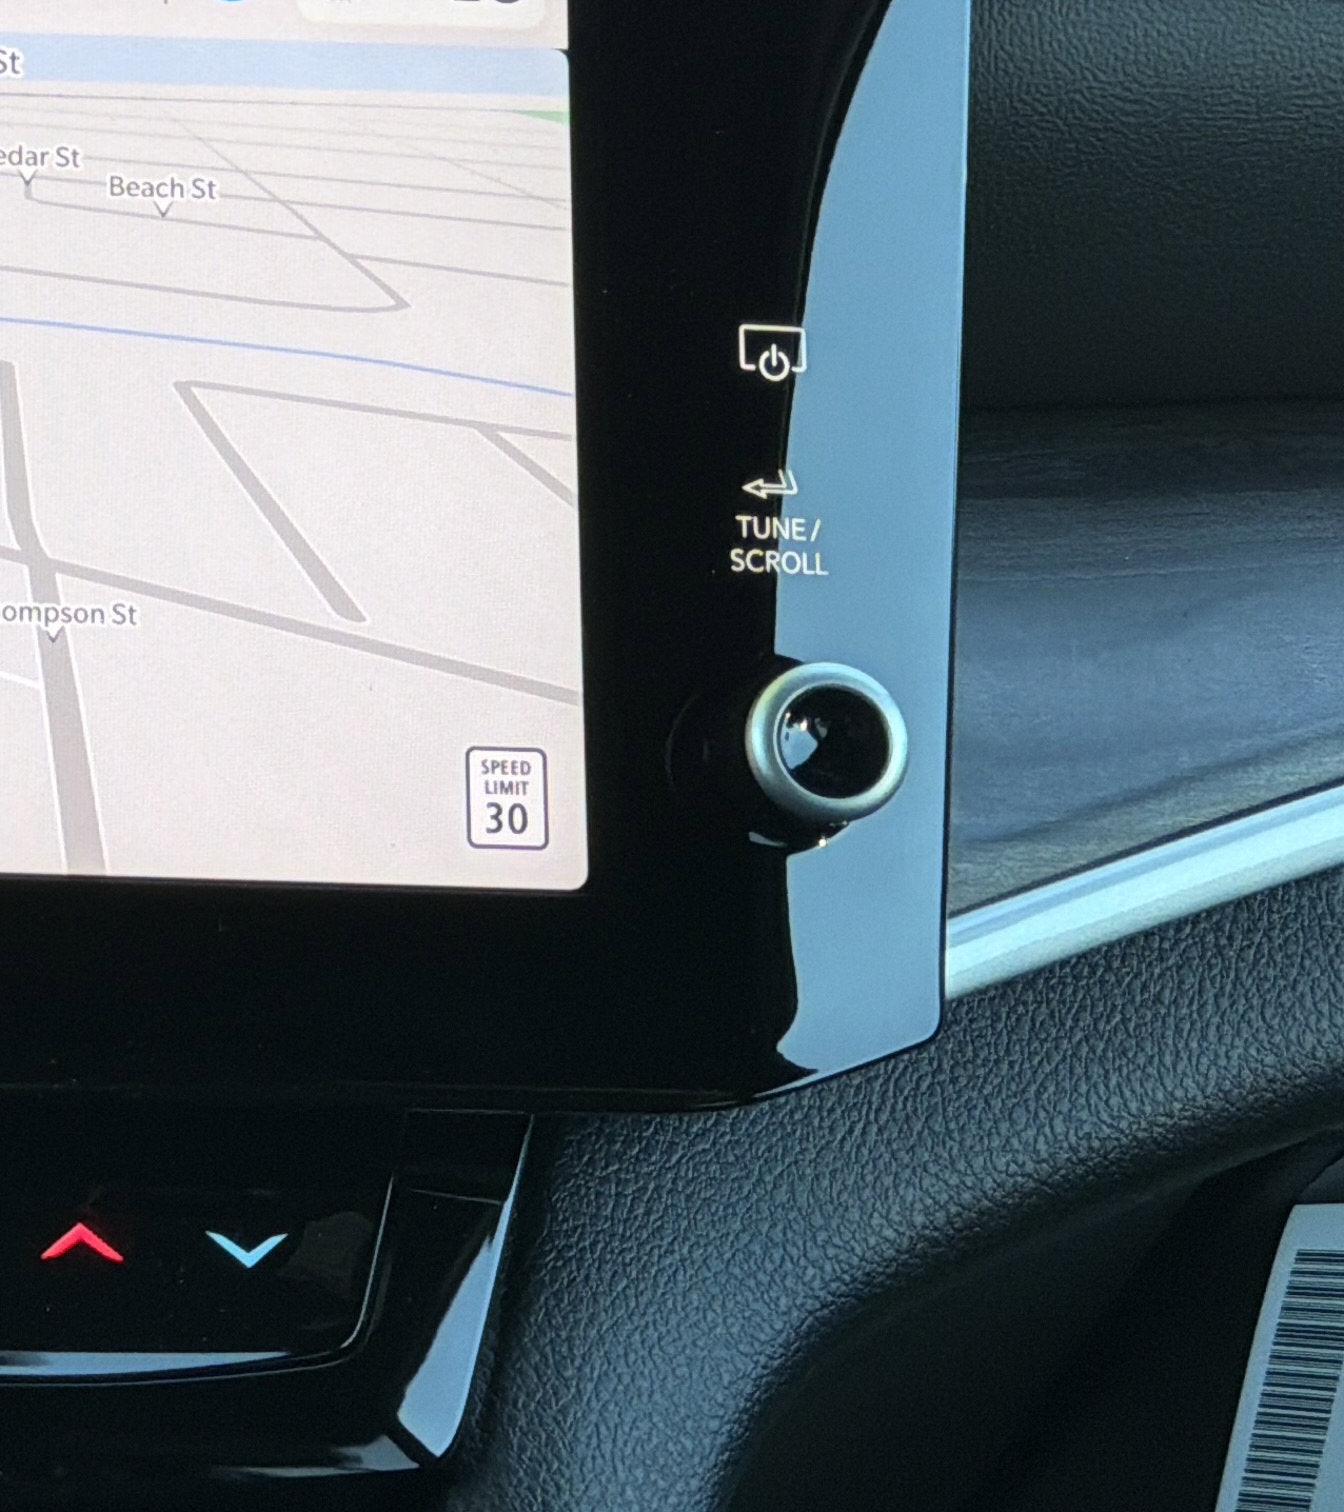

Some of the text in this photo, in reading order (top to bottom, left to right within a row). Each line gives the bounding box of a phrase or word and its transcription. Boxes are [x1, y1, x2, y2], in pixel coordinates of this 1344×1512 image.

[52, 145, 80, 168] St
[109, 175, 217, 200] Beach St
[736, 515, 822, 542] TUNE/
[729, 548, 829, 576] SCROLL
[112, 602, 137, 625] St
[481, 759, 532, 776] SPEED
[484, 780, 529, 795] LIMIT
[485, 801, 528, 835] 30
